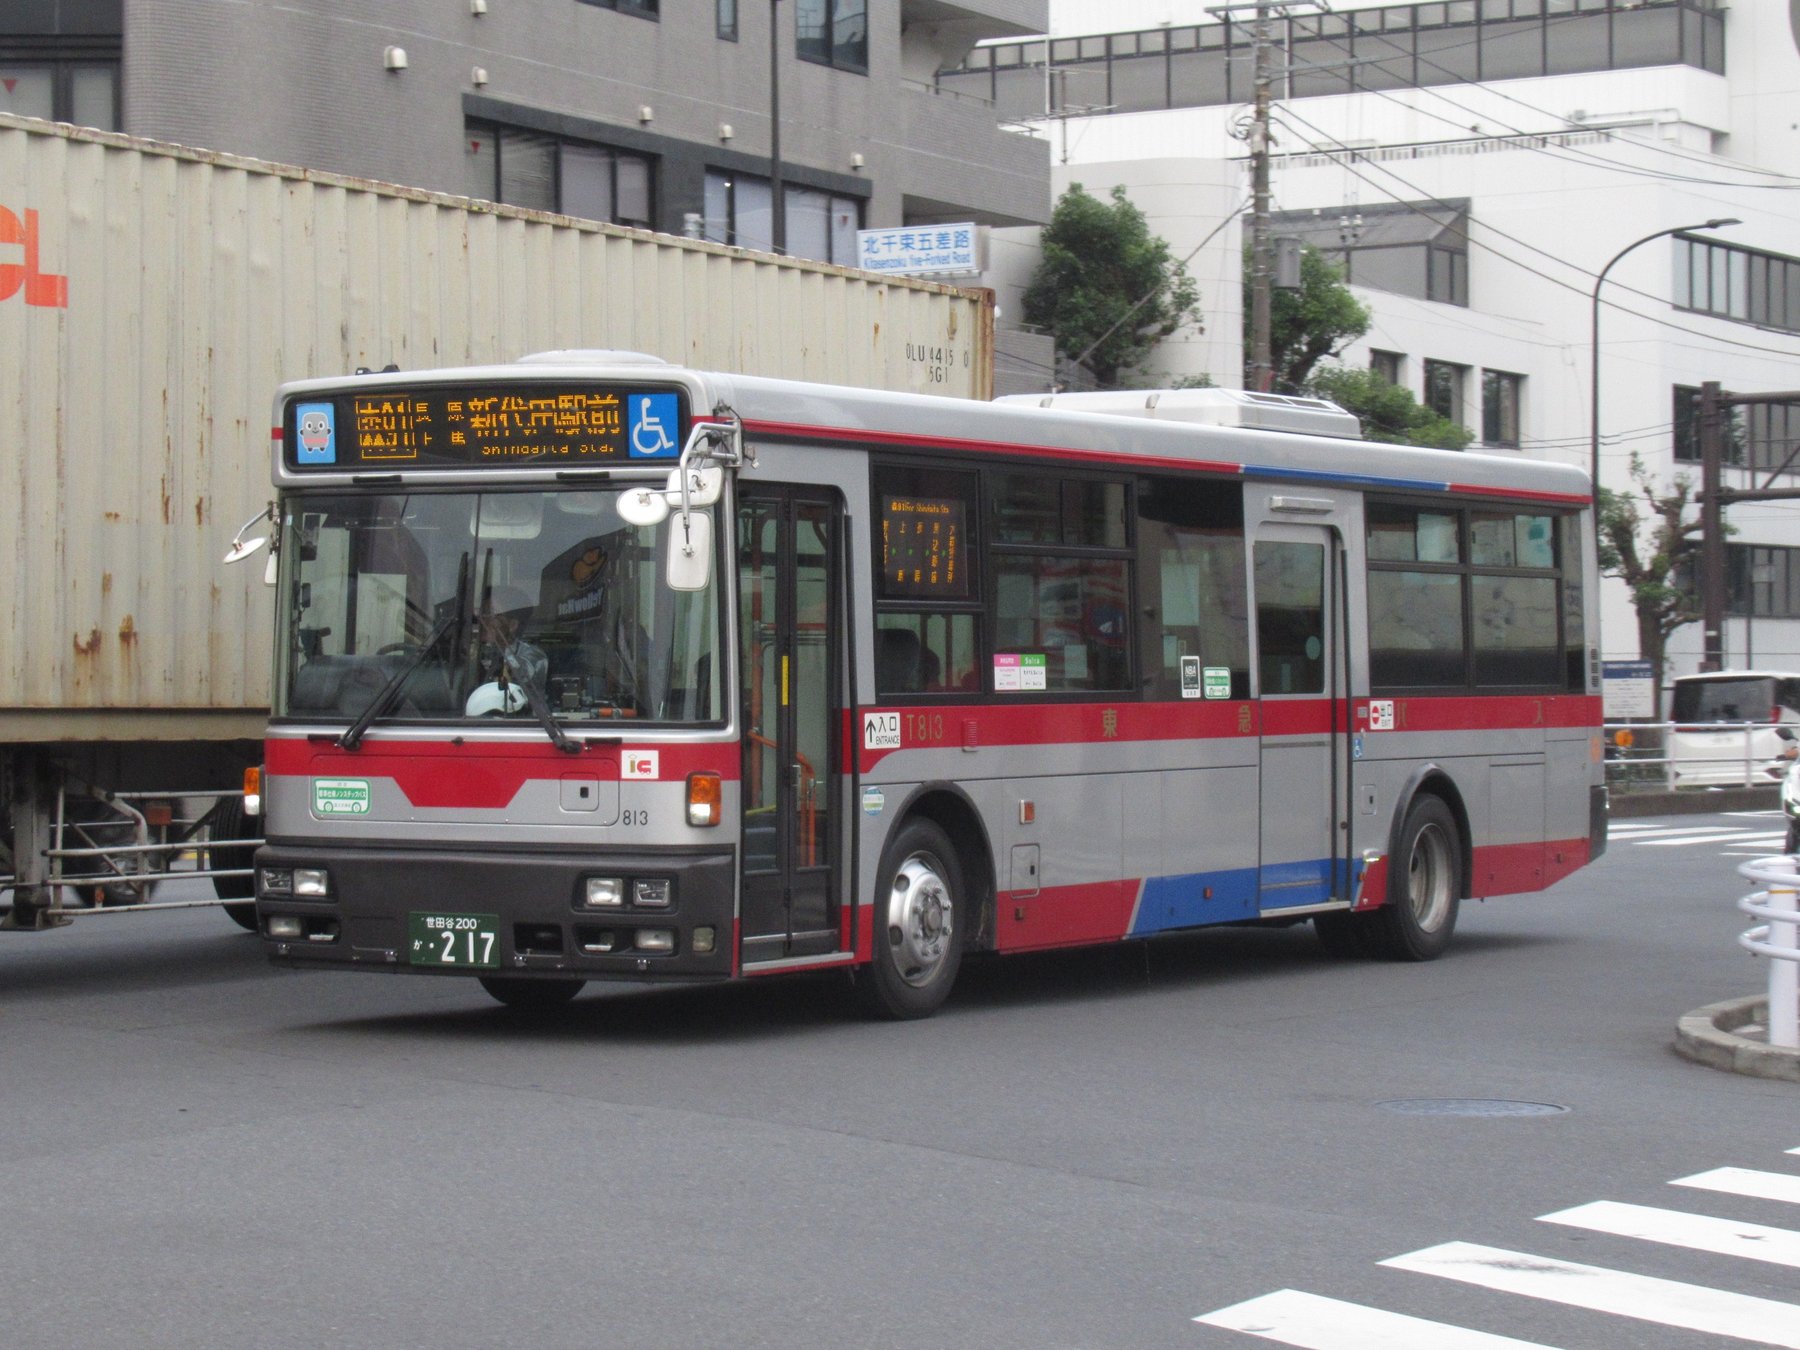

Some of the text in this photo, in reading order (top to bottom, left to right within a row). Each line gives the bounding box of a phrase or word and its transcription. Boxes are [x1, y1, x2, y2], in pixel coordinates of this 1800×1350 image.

[864, 230, 969, 254] 北千束五差路
[879, 717, 897, 732] 入口
[906, 714, 943, 741] T813
[1103, 708, 1118, 738] 東
[1238, 704, 1251, 733] 急
[876, 735, 900, 745] ENTRANCE
[623, 809, 648, 827] 813
